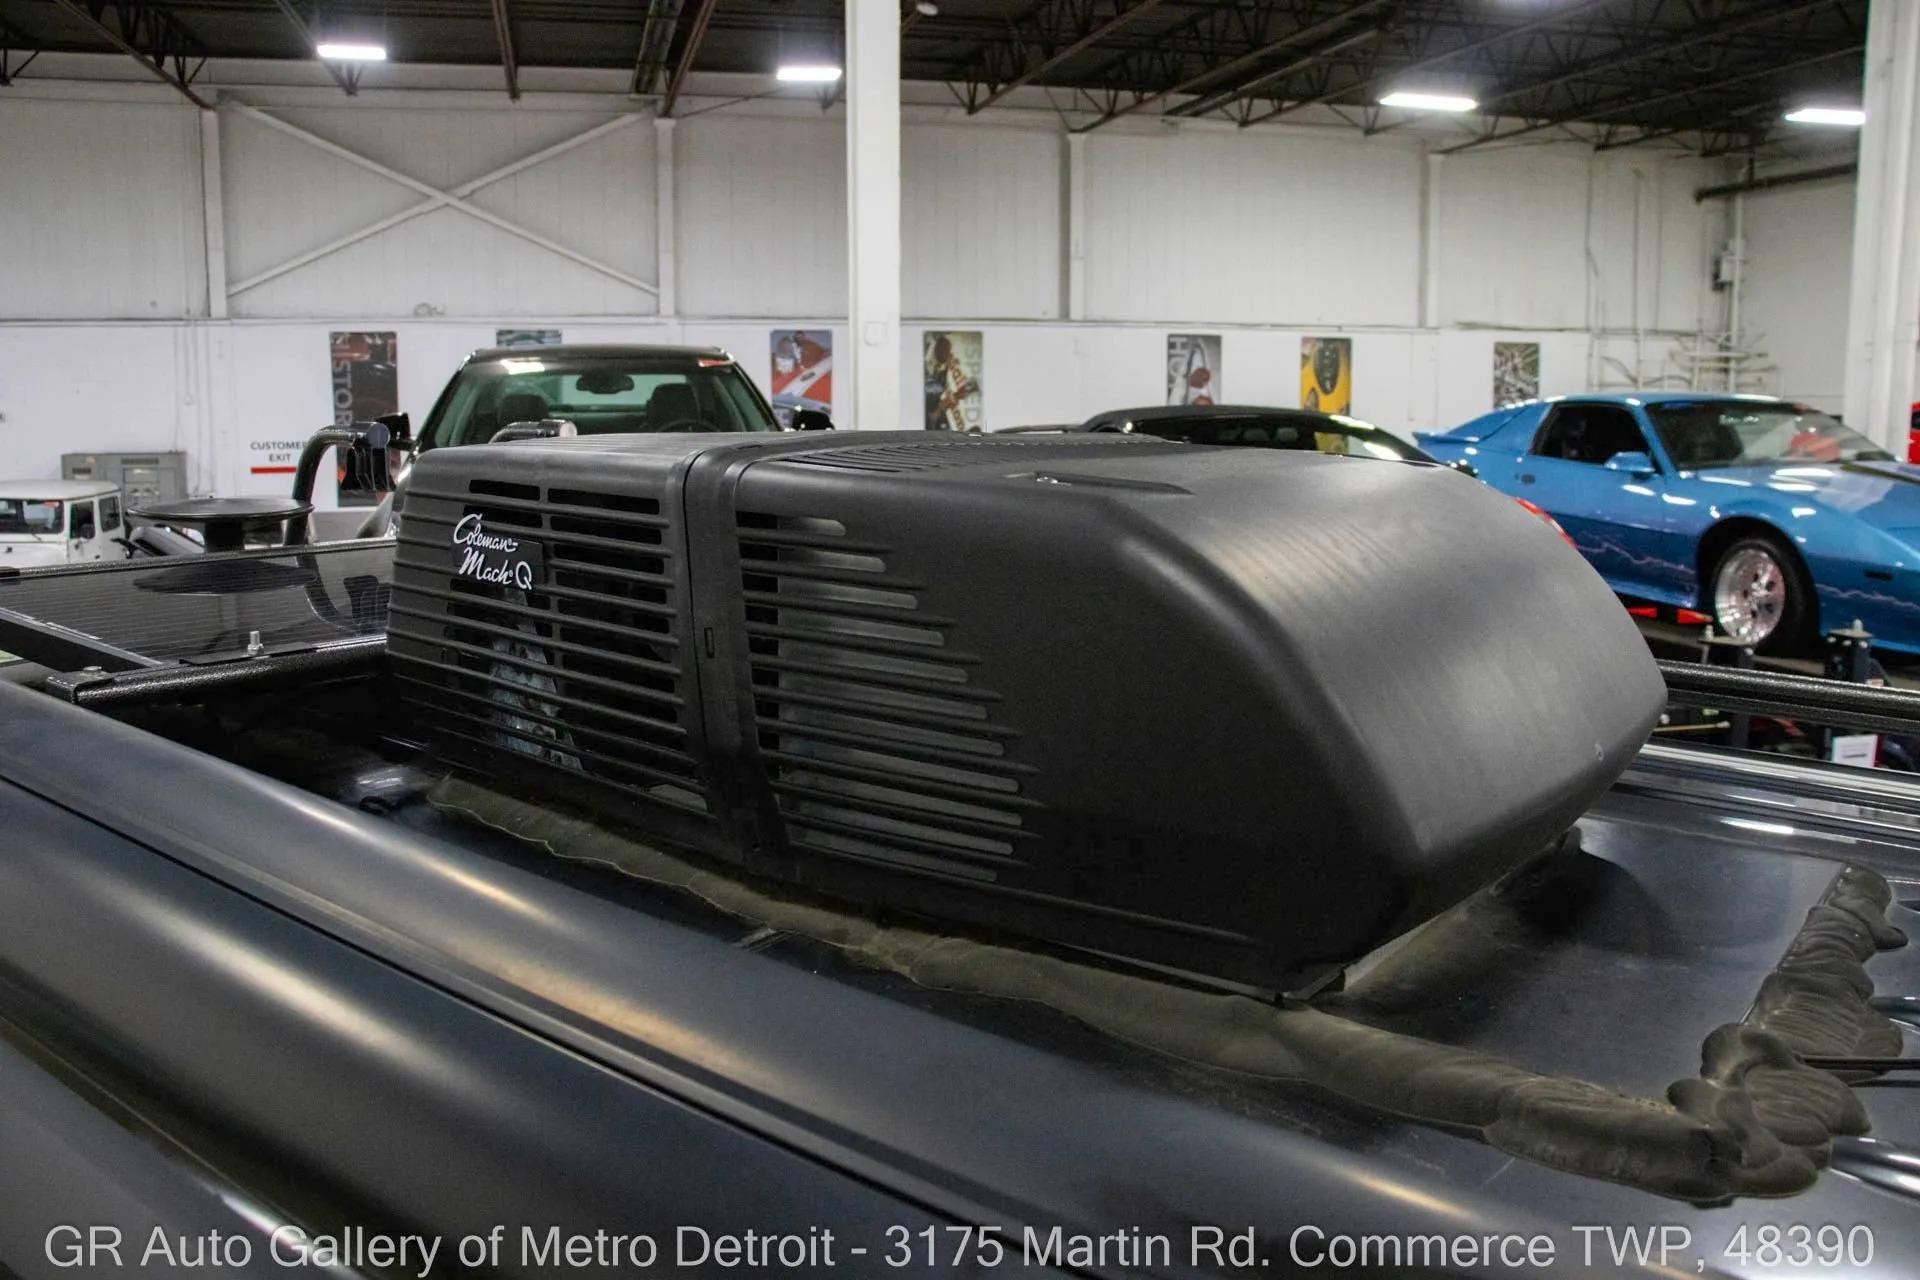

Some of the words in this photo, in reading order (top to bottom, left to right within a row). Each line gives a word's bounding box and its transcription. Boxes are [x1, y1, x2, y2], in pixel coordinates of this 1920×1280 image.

[332, 334, 352, 426] HISTOR
[965, 345, 982, 423] SPED
[269, 453, 291, 462] EXIT
[515, 561, 532, 590] Q
